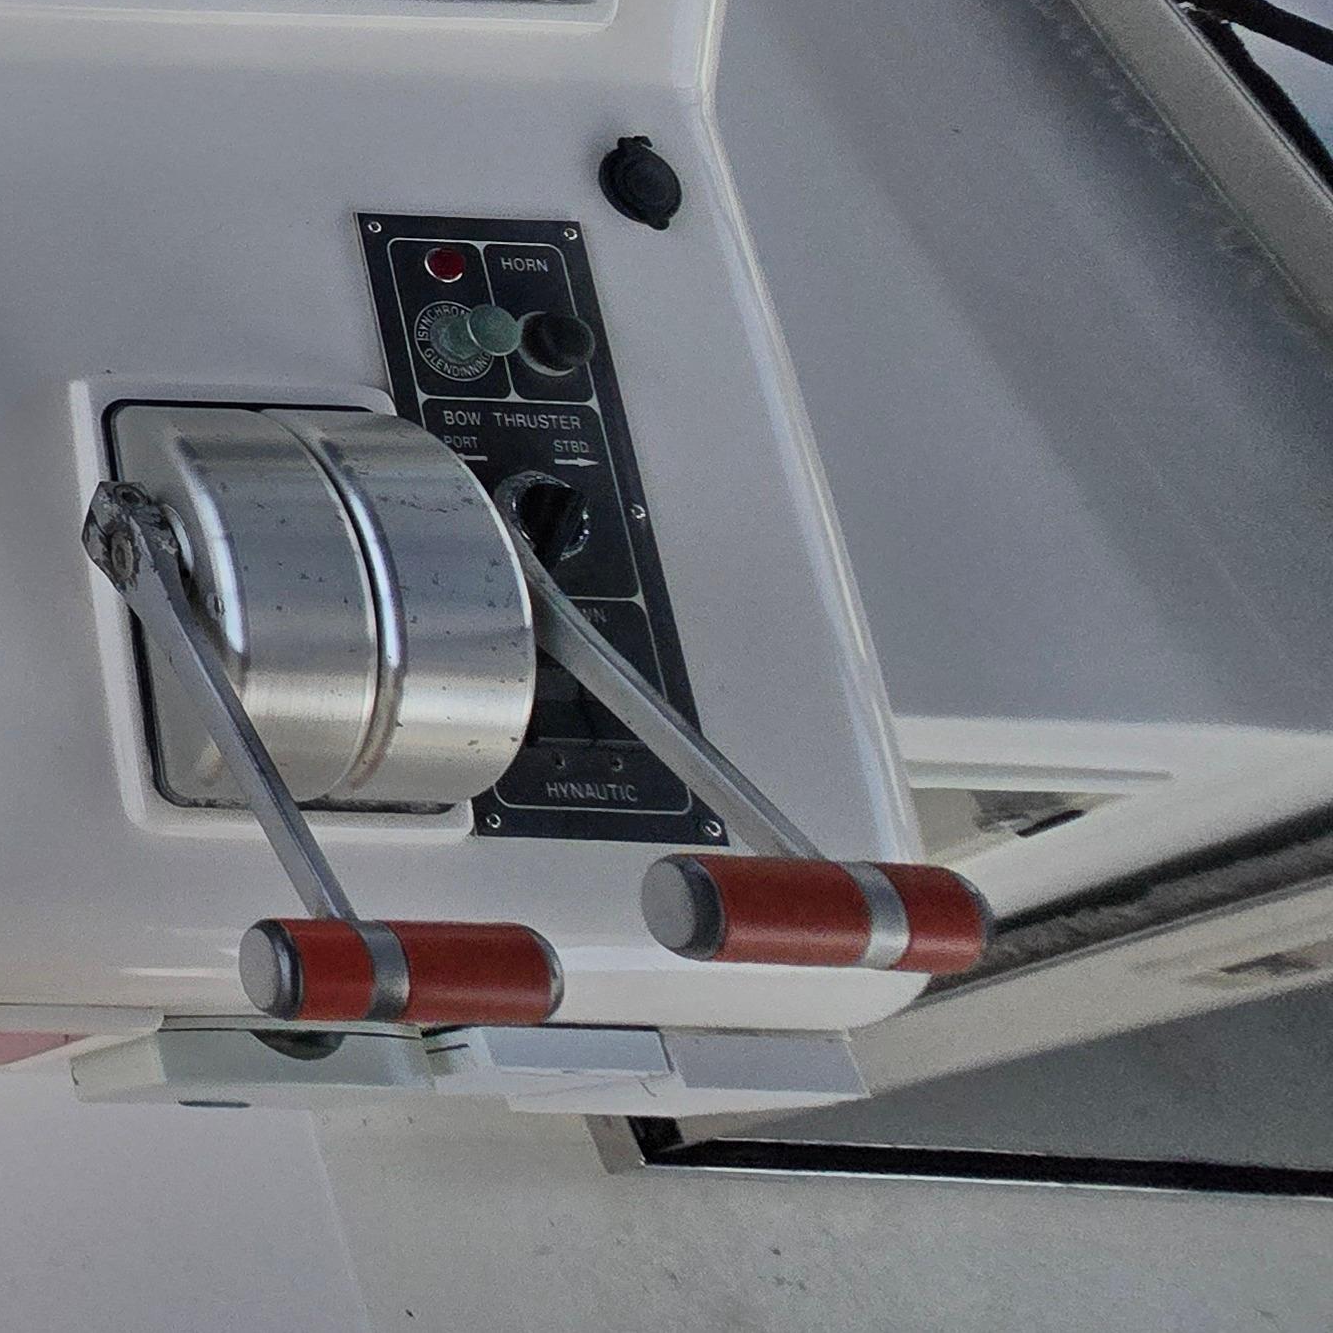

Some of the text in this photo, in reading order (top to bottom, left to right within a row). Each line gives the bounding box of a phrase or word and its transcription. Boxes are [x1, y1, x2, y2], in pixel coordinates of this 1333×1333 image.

[500, 257, 550, 272] HORN
[443, 410, 581, 430] BOW THRUSTER
[444, 435, 478, 450] PORT
[553, 439, 590, 453] STBD
[545, 781, 639, 802] HYNAUTIC
